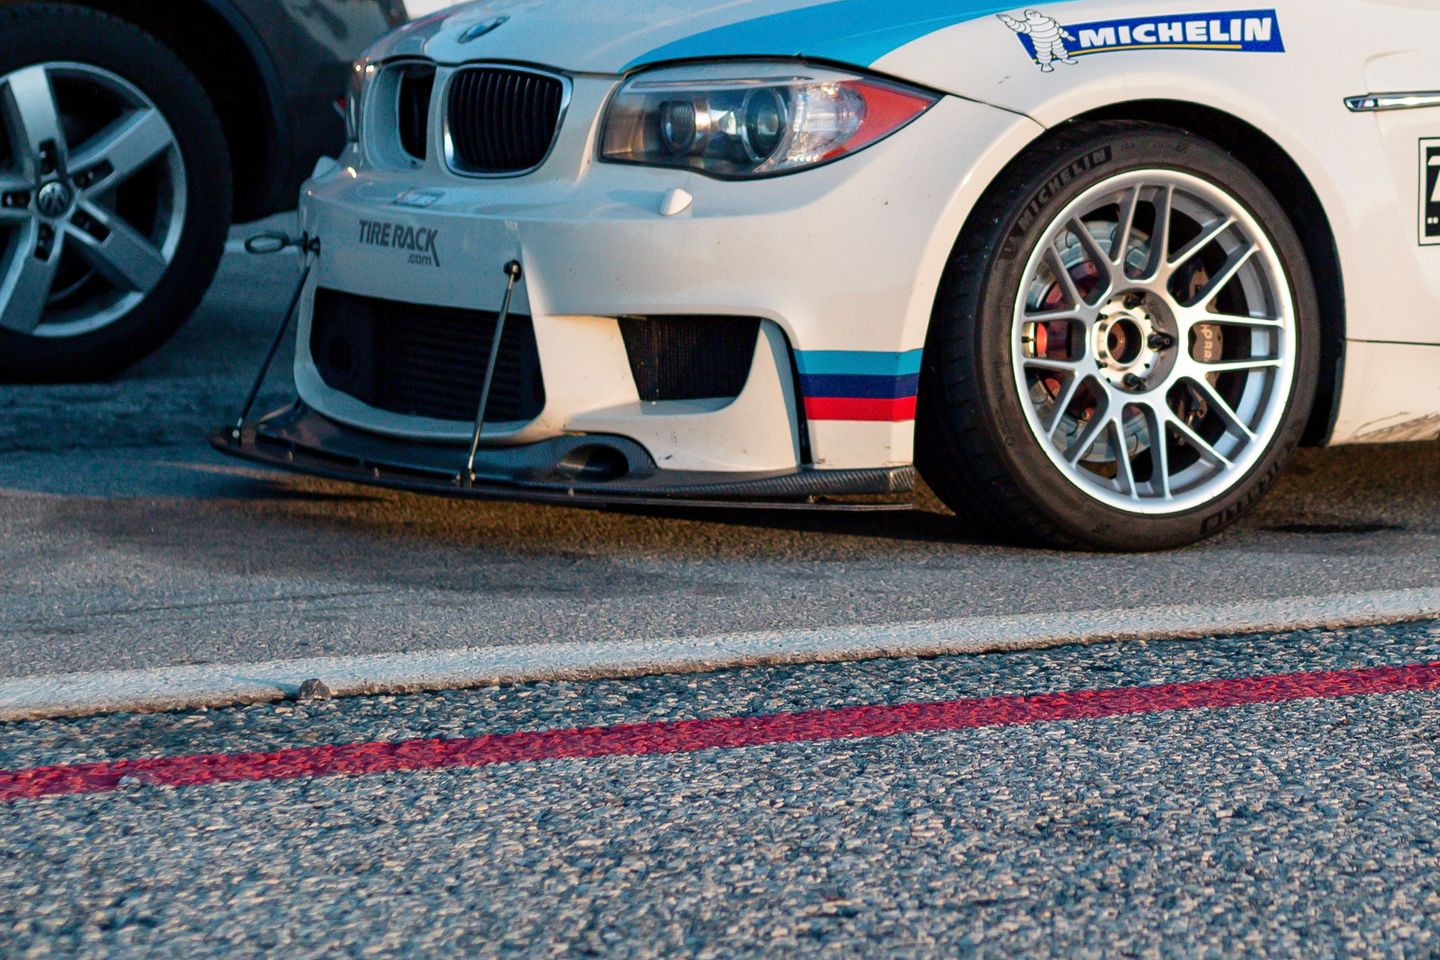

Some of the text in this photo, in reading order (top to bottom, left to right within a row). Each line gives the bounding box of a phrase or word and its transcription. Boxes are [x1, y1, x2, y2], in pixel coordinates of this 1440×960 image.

[1078, 17, 1272, 49] MICHELIN
[358, 219, 441, 268] TIRE RACK
[408, 253, 433, 266] .com
